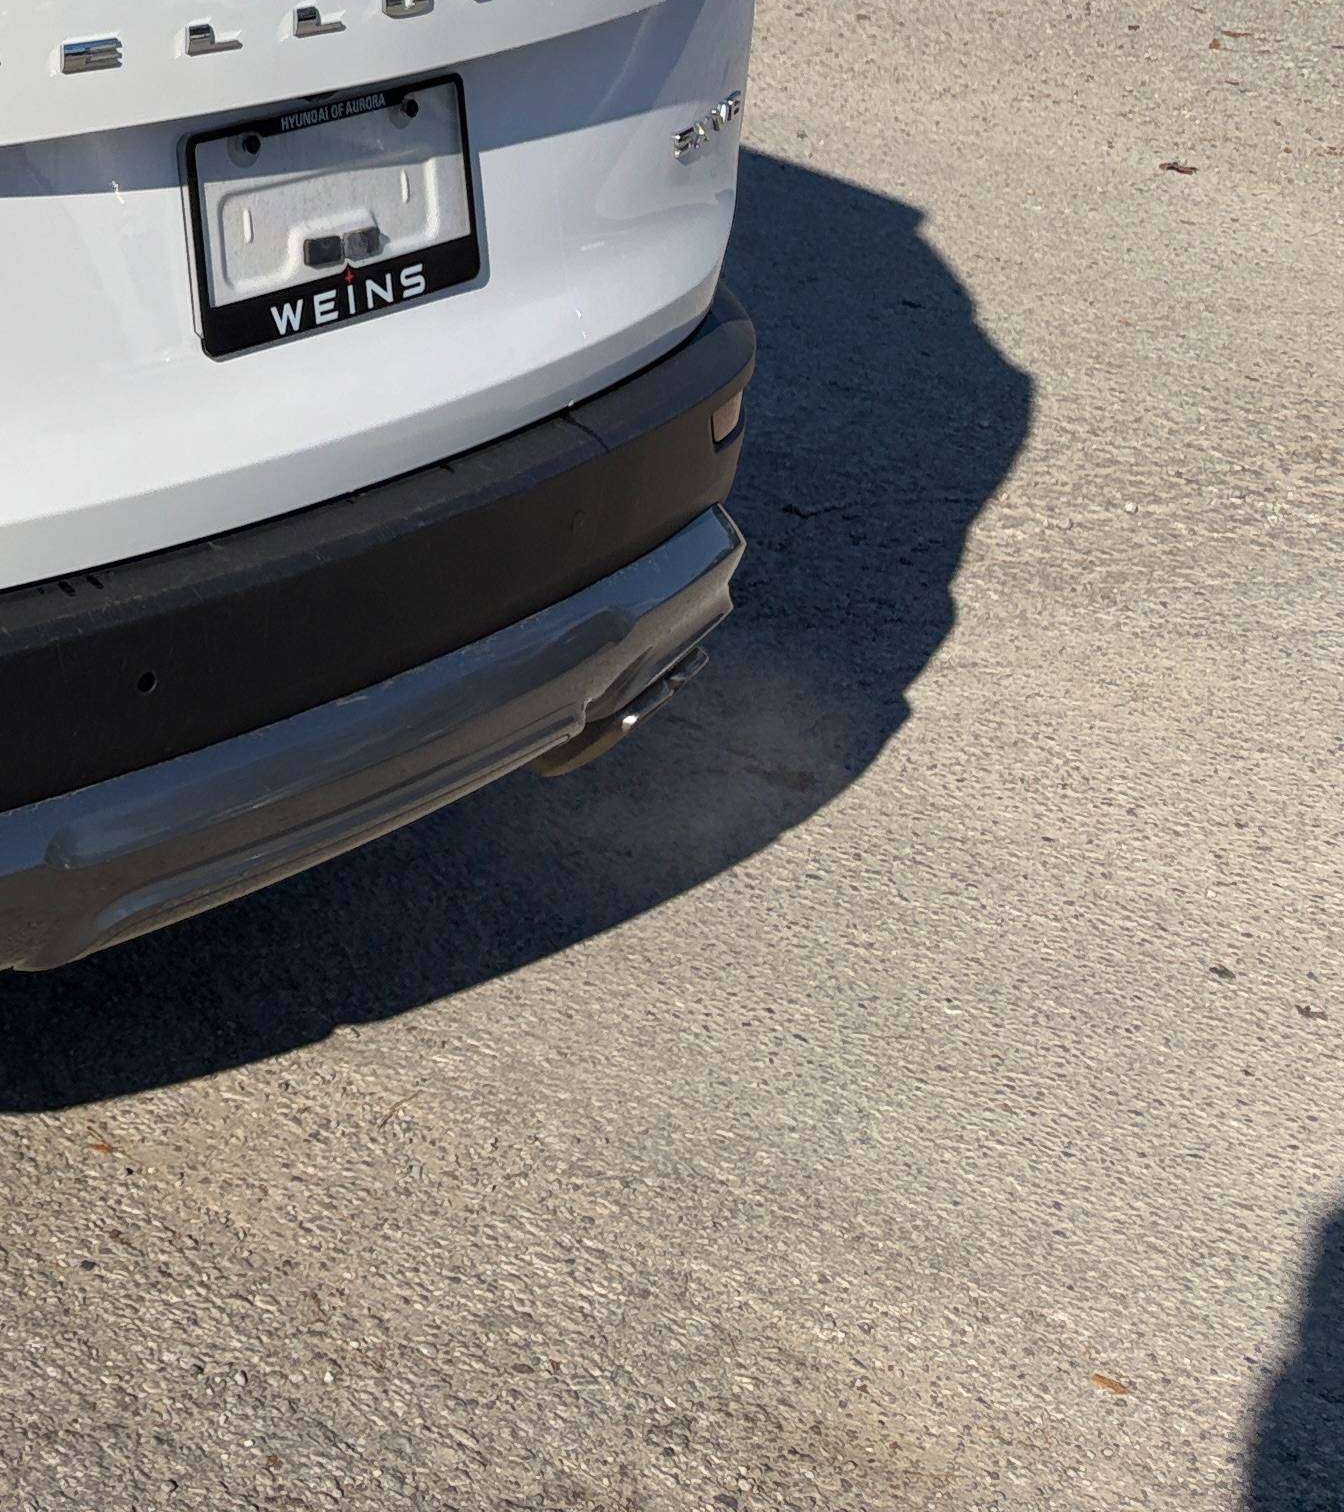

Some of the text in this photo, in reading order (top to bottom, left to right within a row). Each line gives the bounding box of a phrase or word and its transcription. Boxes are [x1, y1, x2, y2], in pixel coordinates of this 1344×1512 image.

[280, 93, 387, 131] HYUNDAI OF AURORA
[270, 263, 426, 336] WEINS
